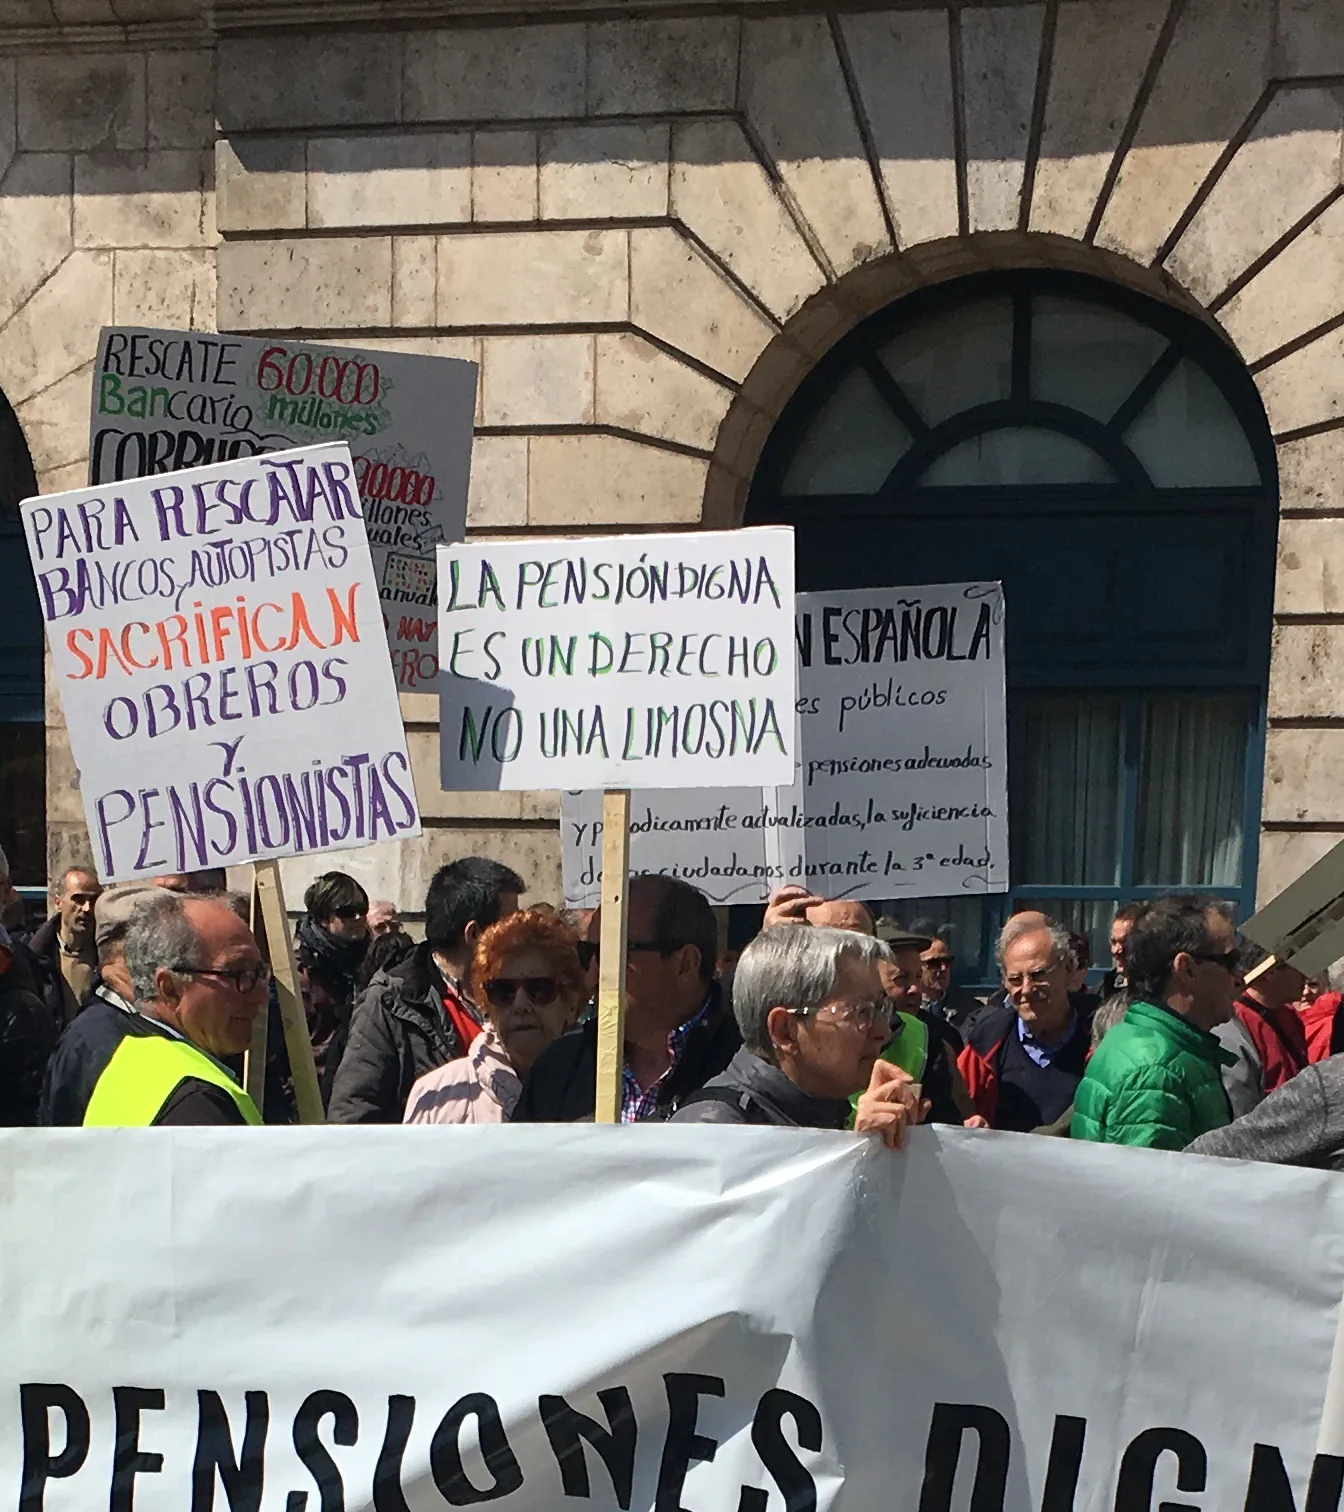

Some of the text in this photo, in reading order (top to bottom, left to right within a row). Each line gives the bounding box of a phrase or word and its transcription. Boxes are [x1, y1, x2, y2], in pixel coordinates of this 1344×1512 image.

[102, 333, 242, 385] RESCATE
[98, 373, 253, 432] Bancario
[267, 393, 377, 436] millones
[92, 428, 285, 486] CORRUP
[30, 458, 363, 560] PARA RESCATAR
[360, 498, 432, 527] illones
[38, 557, 175, 621] BANCOS
[189, 525, 348, 589] AUTOPISTAS
[446, 552, 781, 612] LA PENSIÓN DIGNA
[66, 582, 361, 680] SACRIFICAN
[449, 628, 506, 680] ES
[522, 635, 577, 677] UN
[588, 631, 778, 679] DERECHO
[822, 598, 991, 666] ESPAÑOLA
[103, 658, 348, 741] OBREROS
[839, 677, 947, 732] públicos
[207, 735, 244, 776] Y
[458, 697, 788, 765] NO UNA LIMOSNA
[808, 756, 902, 786] pensiones
[94, 752, 416, 878] PENSIONISTAS
[867, 798, 887, 824] la
[891, 803, 997, 831] suficiencia
[789, 850, 877, 878] durante
[884, 850, 906, 876] la
[939, 843, 995, 870] edad.
